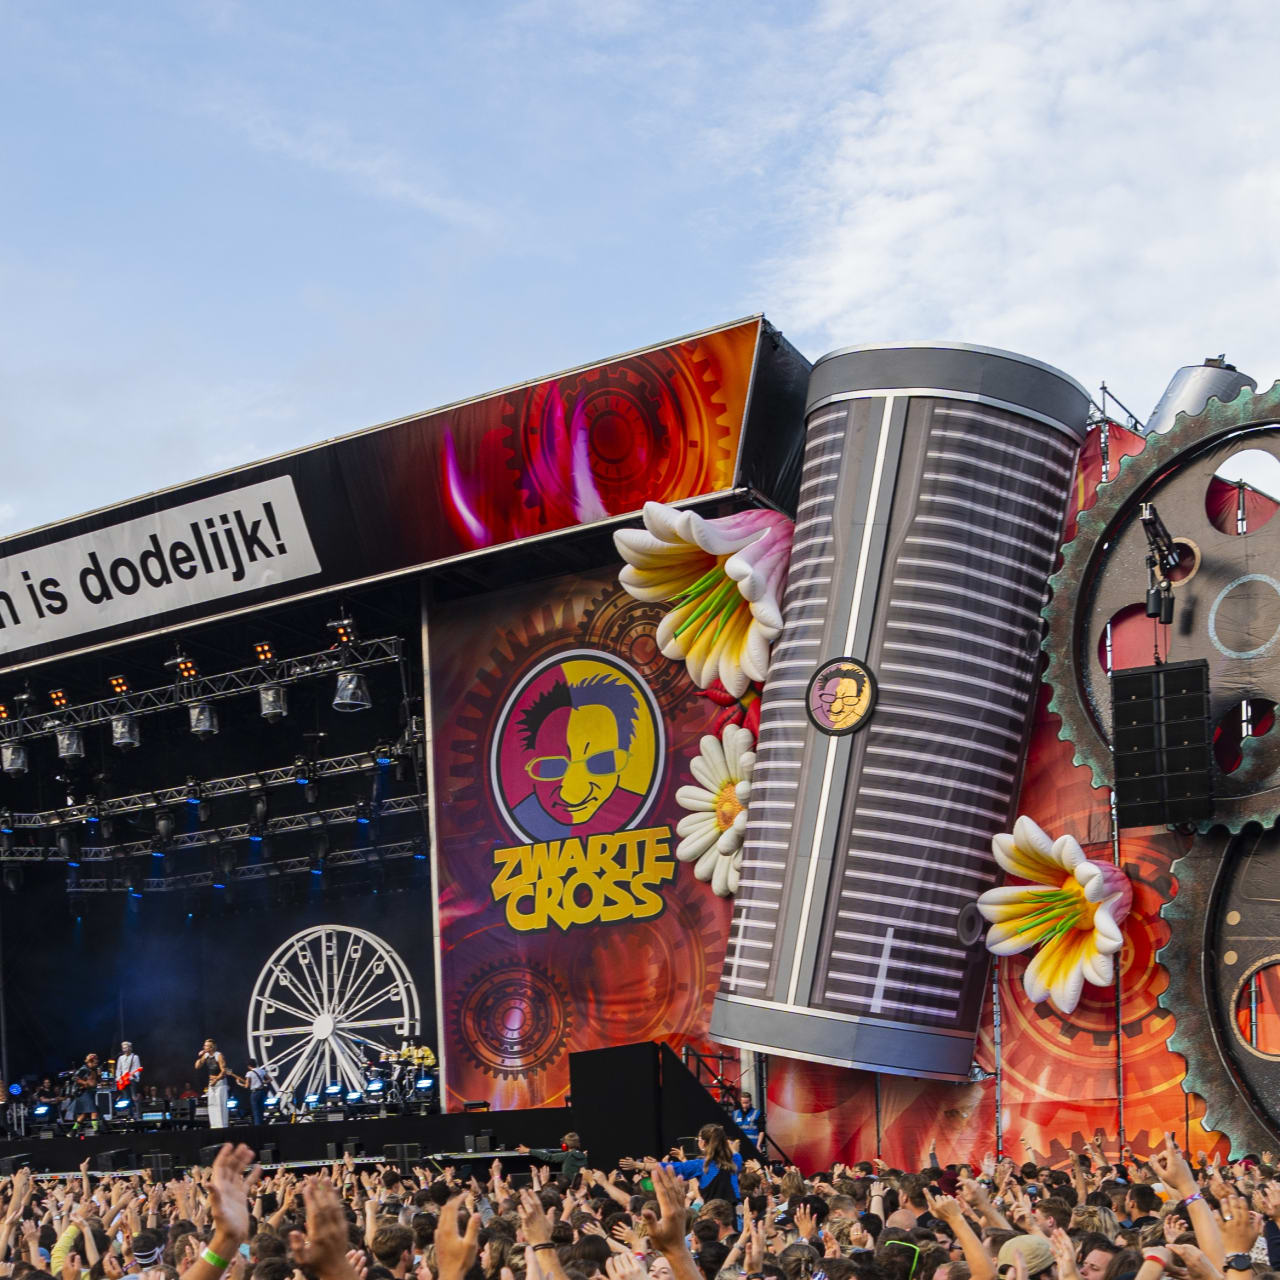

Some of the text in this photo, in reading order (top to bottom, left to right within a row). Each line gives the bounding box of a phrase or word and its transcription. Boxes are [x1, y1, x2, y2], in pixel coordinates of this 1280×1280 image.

[21, 571, 68, 619] is
[79, 501, 288, 605] dodelijk!
[491, 827, 675, 901] ZWARTE
[505, 871, 664, 931] CROSS
